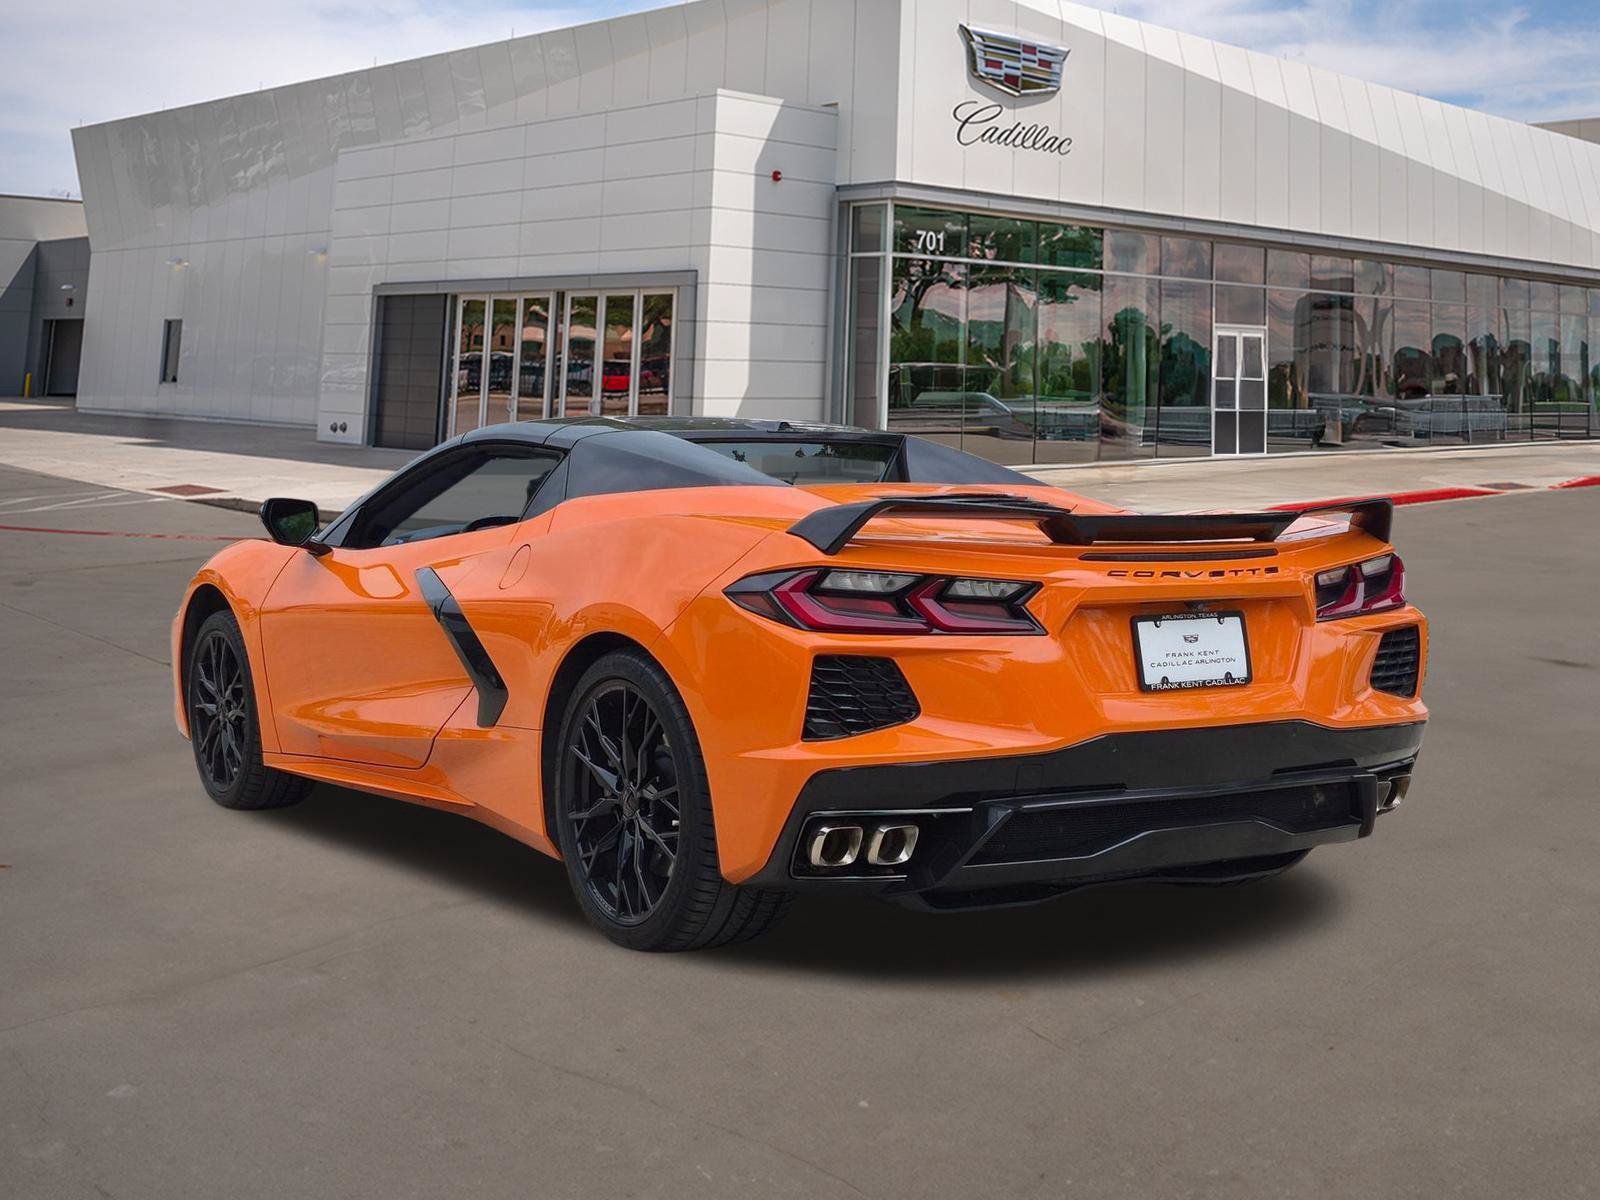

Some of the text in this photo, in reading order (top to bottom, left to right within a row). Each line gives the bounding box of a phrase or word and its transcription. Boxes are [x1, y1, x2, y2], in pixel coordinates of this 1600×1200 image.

[953, 101, 1072, 156] Cadillac
[916, 230, 944, 251] 701
[1107, 566, 1279, 578] CORVETTE
[1198, 649, 1219, 657] KENT
[1150, 657, 1236, 668] CADILLAC ARLINGTON
[1151, 678, 1246, 691] FRANK KENT CADILLAC
